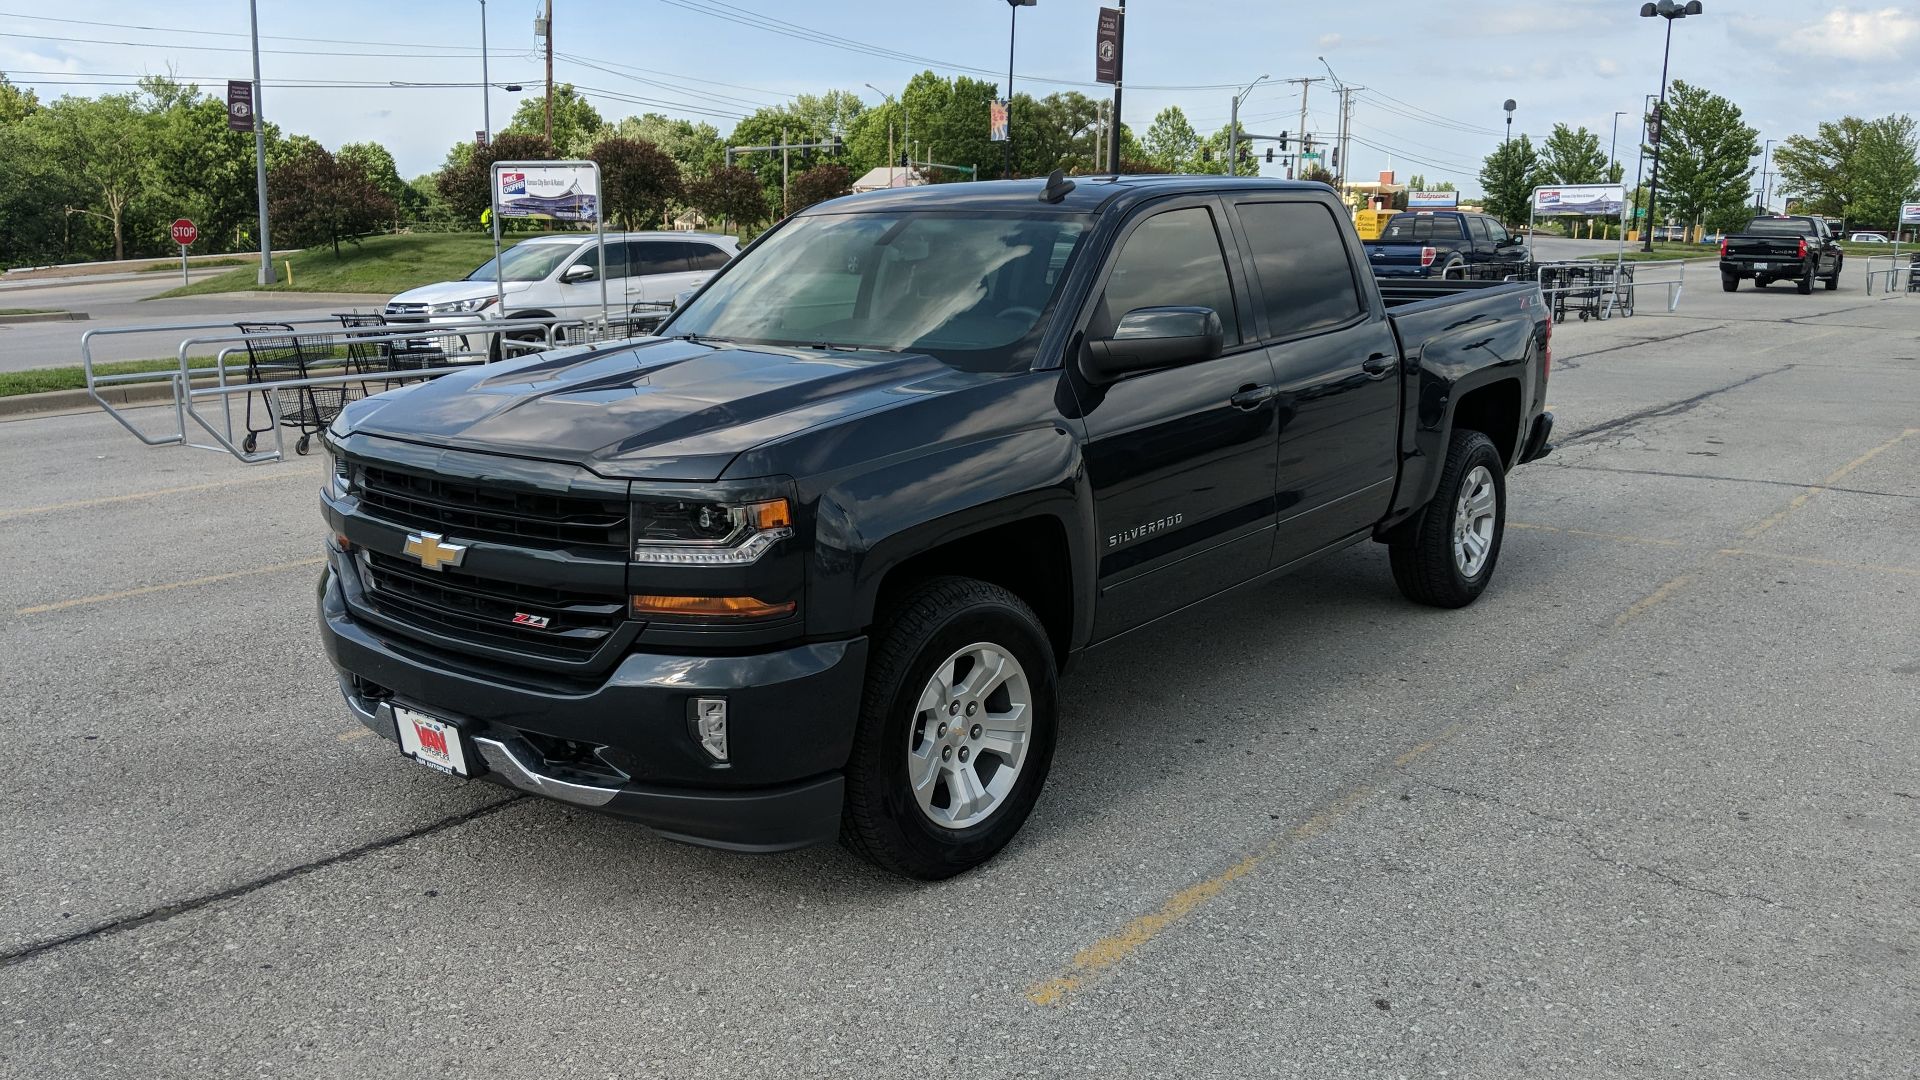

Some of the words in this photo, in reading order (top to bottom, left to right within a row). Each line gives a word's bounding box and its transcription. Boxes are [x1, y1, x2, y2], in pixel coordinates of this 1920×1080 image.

[503, 174, 517, 184] PRICE
[503, 180, 525, 194] CHOPPER
[1415, 192, 1450, 200] Walgreens
[173, 226, 195, 237] STOP
[1108, 513, 1183, 547] SILVERADO
[512, 612, 550, 628] Z71
[411, 718, 449, 755] VAN
